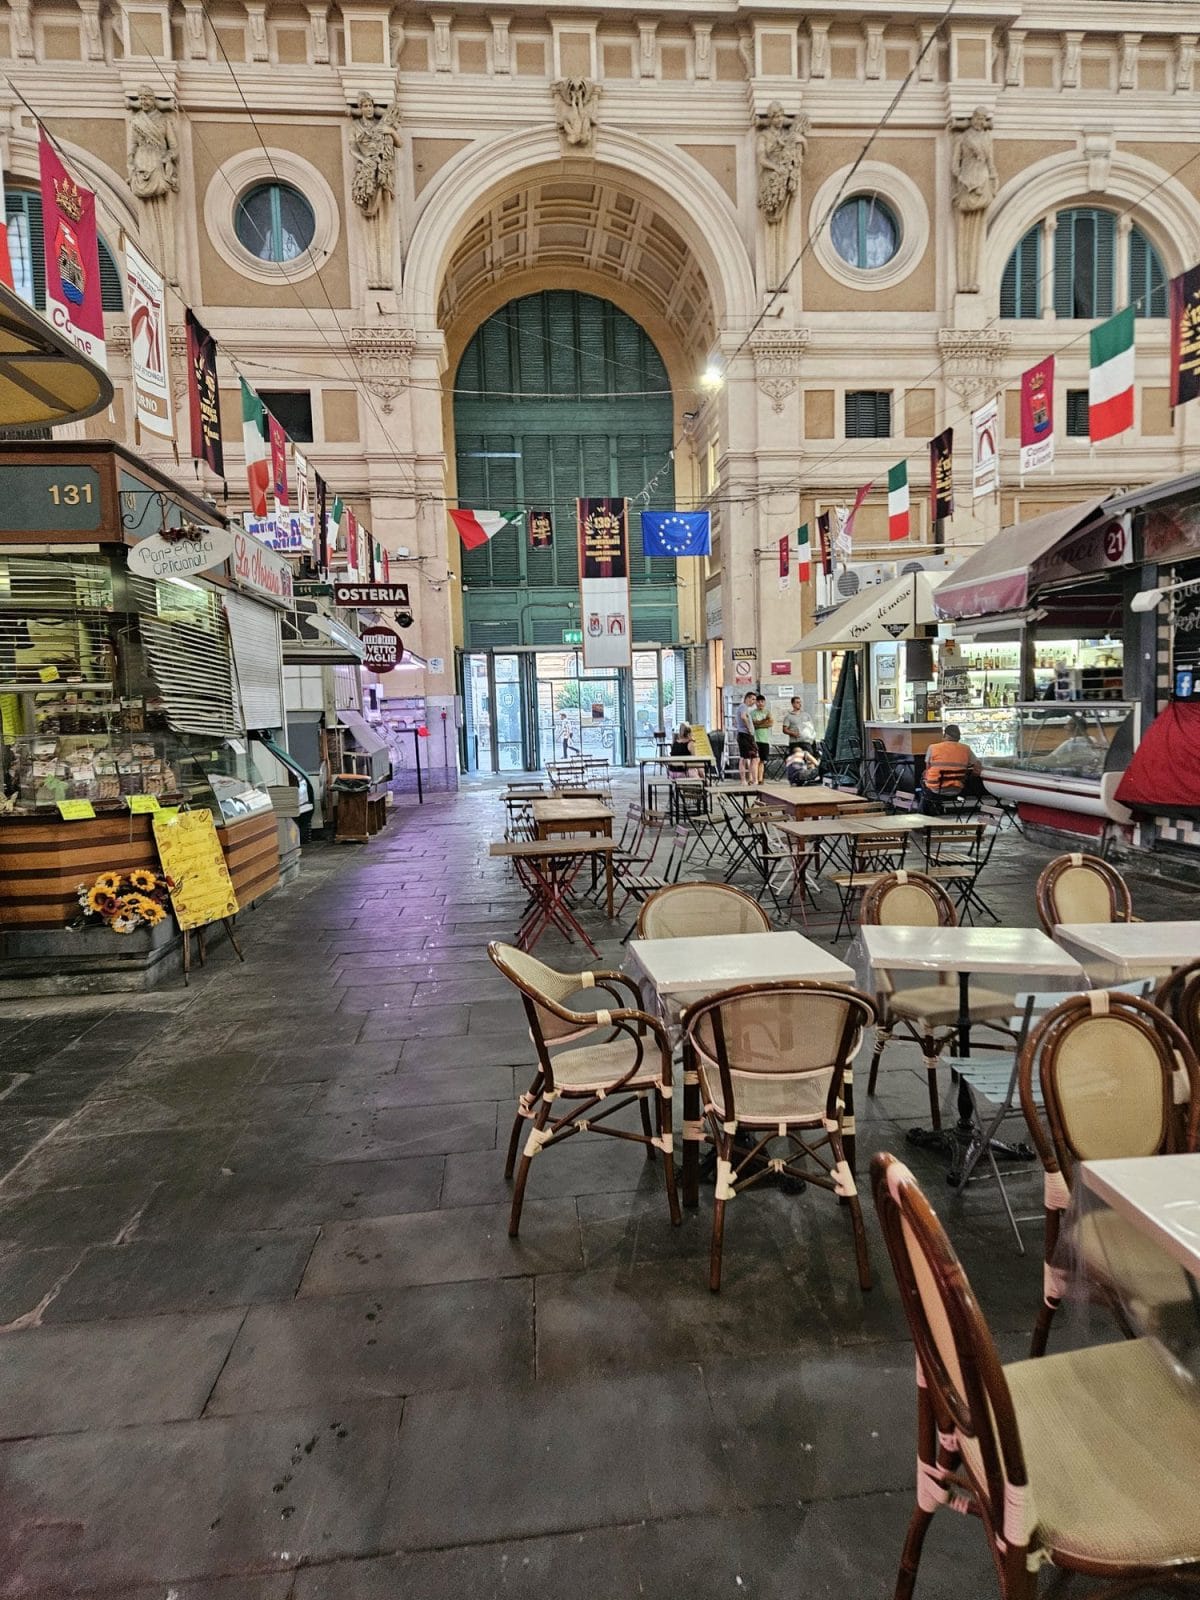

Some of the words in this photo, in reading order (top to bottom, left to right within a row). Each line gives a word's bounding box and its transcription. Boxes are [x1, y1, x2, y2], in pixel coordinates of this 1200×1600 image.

[48, 483, 93, 505] 131
[1107, 530, 1123, 554] 21
[337, 588, 407, 601] OSTERIA
[849, 622, 872, 638] Bar
[367, 645, 397, 654] VETTO
